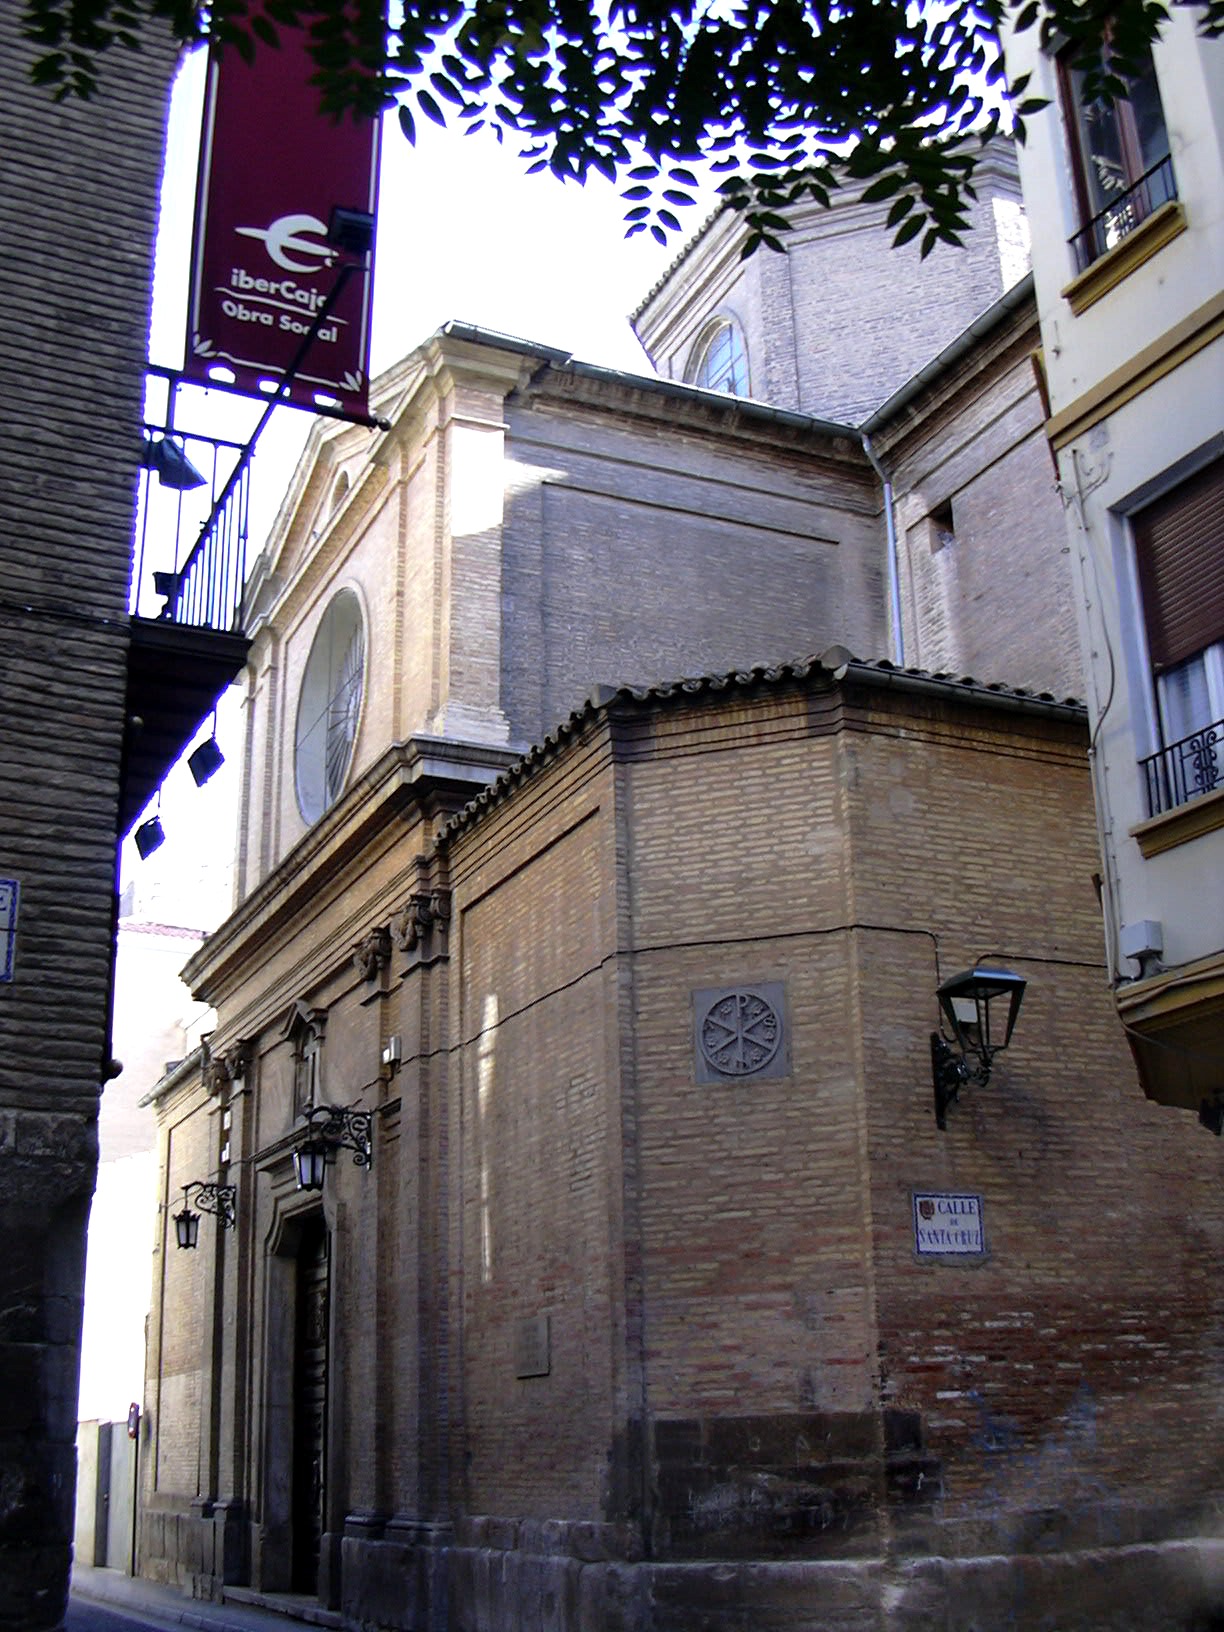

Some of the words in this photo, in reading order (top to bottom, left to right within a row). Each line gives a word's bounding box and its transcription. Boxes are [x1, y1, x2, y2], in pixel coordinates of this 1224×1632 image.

[222, 300, 274, 325] Obra
[279, 315, 338, 342] Socal
[937, 1200, 976, 1215] CALLE
[918, 1229, 952, 1245] SANTA
[954, 1230, 981, 1246] CRUZ
